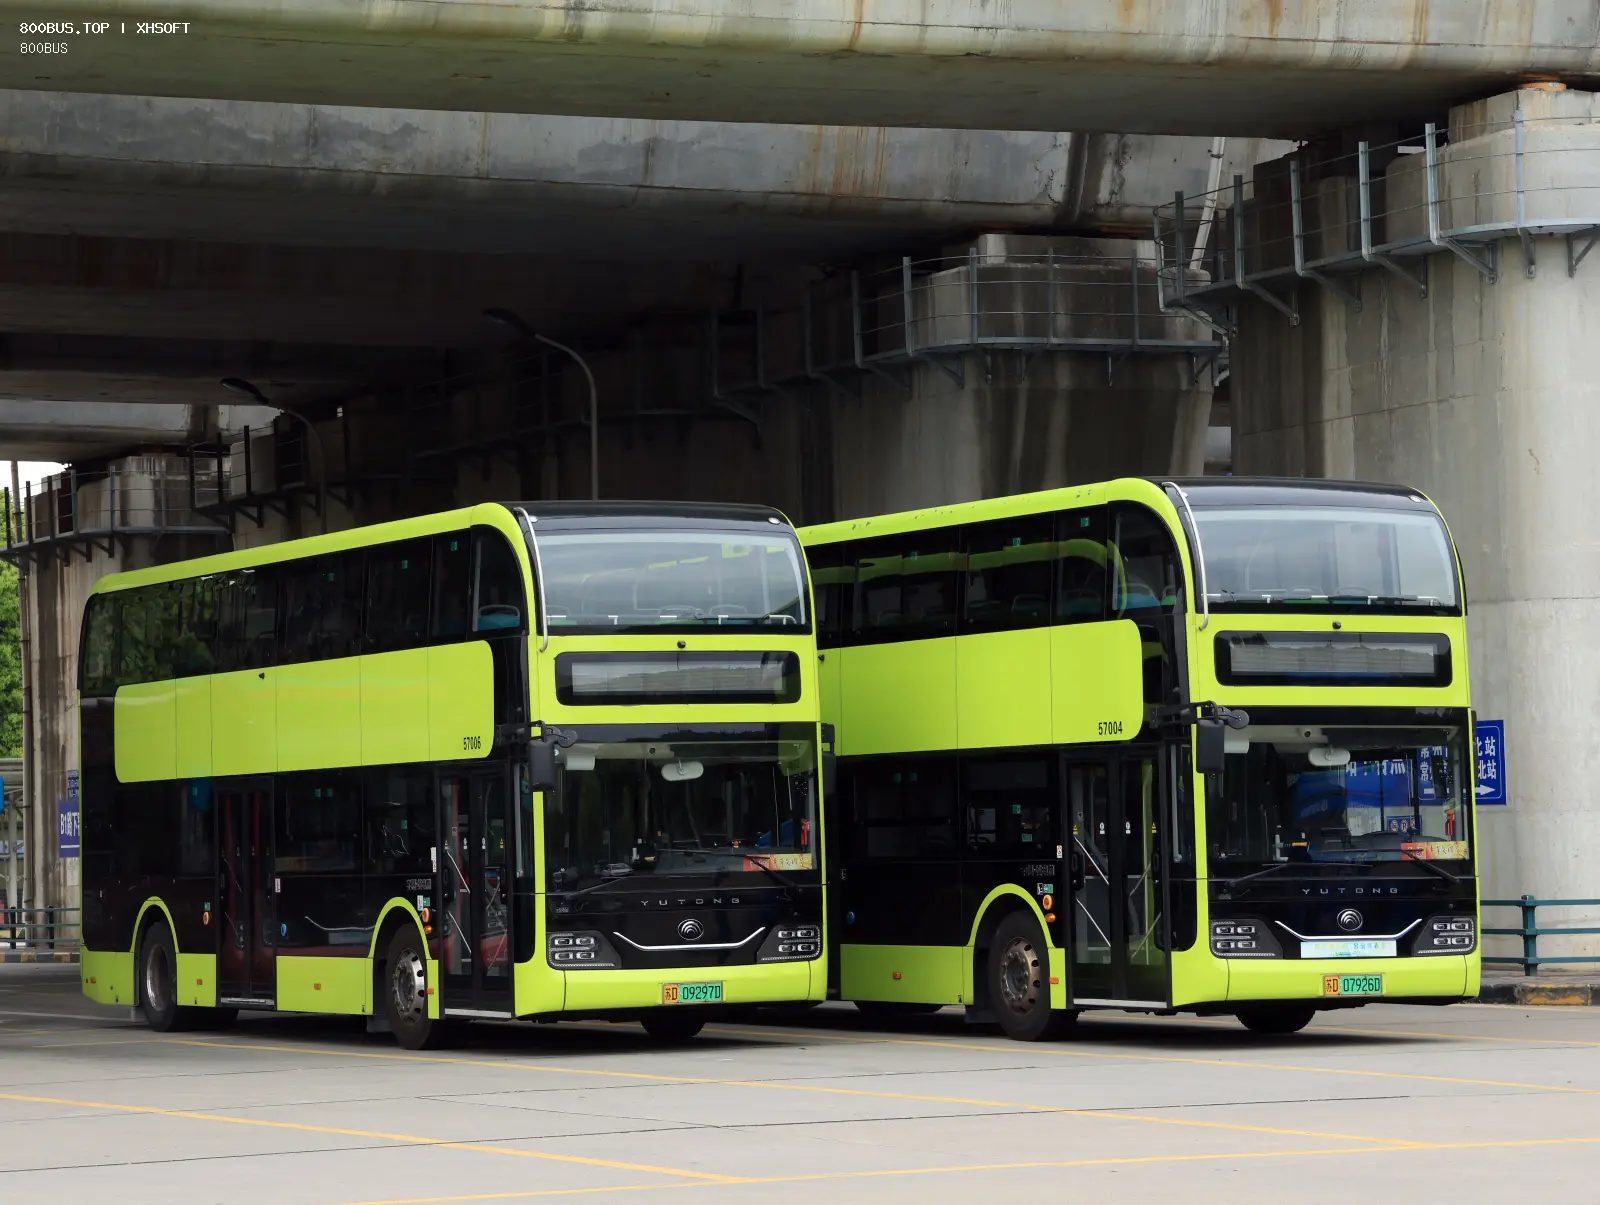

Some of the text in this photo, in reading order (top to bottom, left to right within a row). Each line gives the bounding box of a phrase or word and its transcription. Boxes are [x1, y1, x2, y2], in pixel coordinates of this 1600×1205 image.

[1098, 720, 1123, 736] 57004
[1302, 887, 1398, 895] YUTONG
[640, 897, 740, 906] YUTONG
[1343, 977, 1381, 992] 07926D
[682, 985, 721, 1000] 09297D
